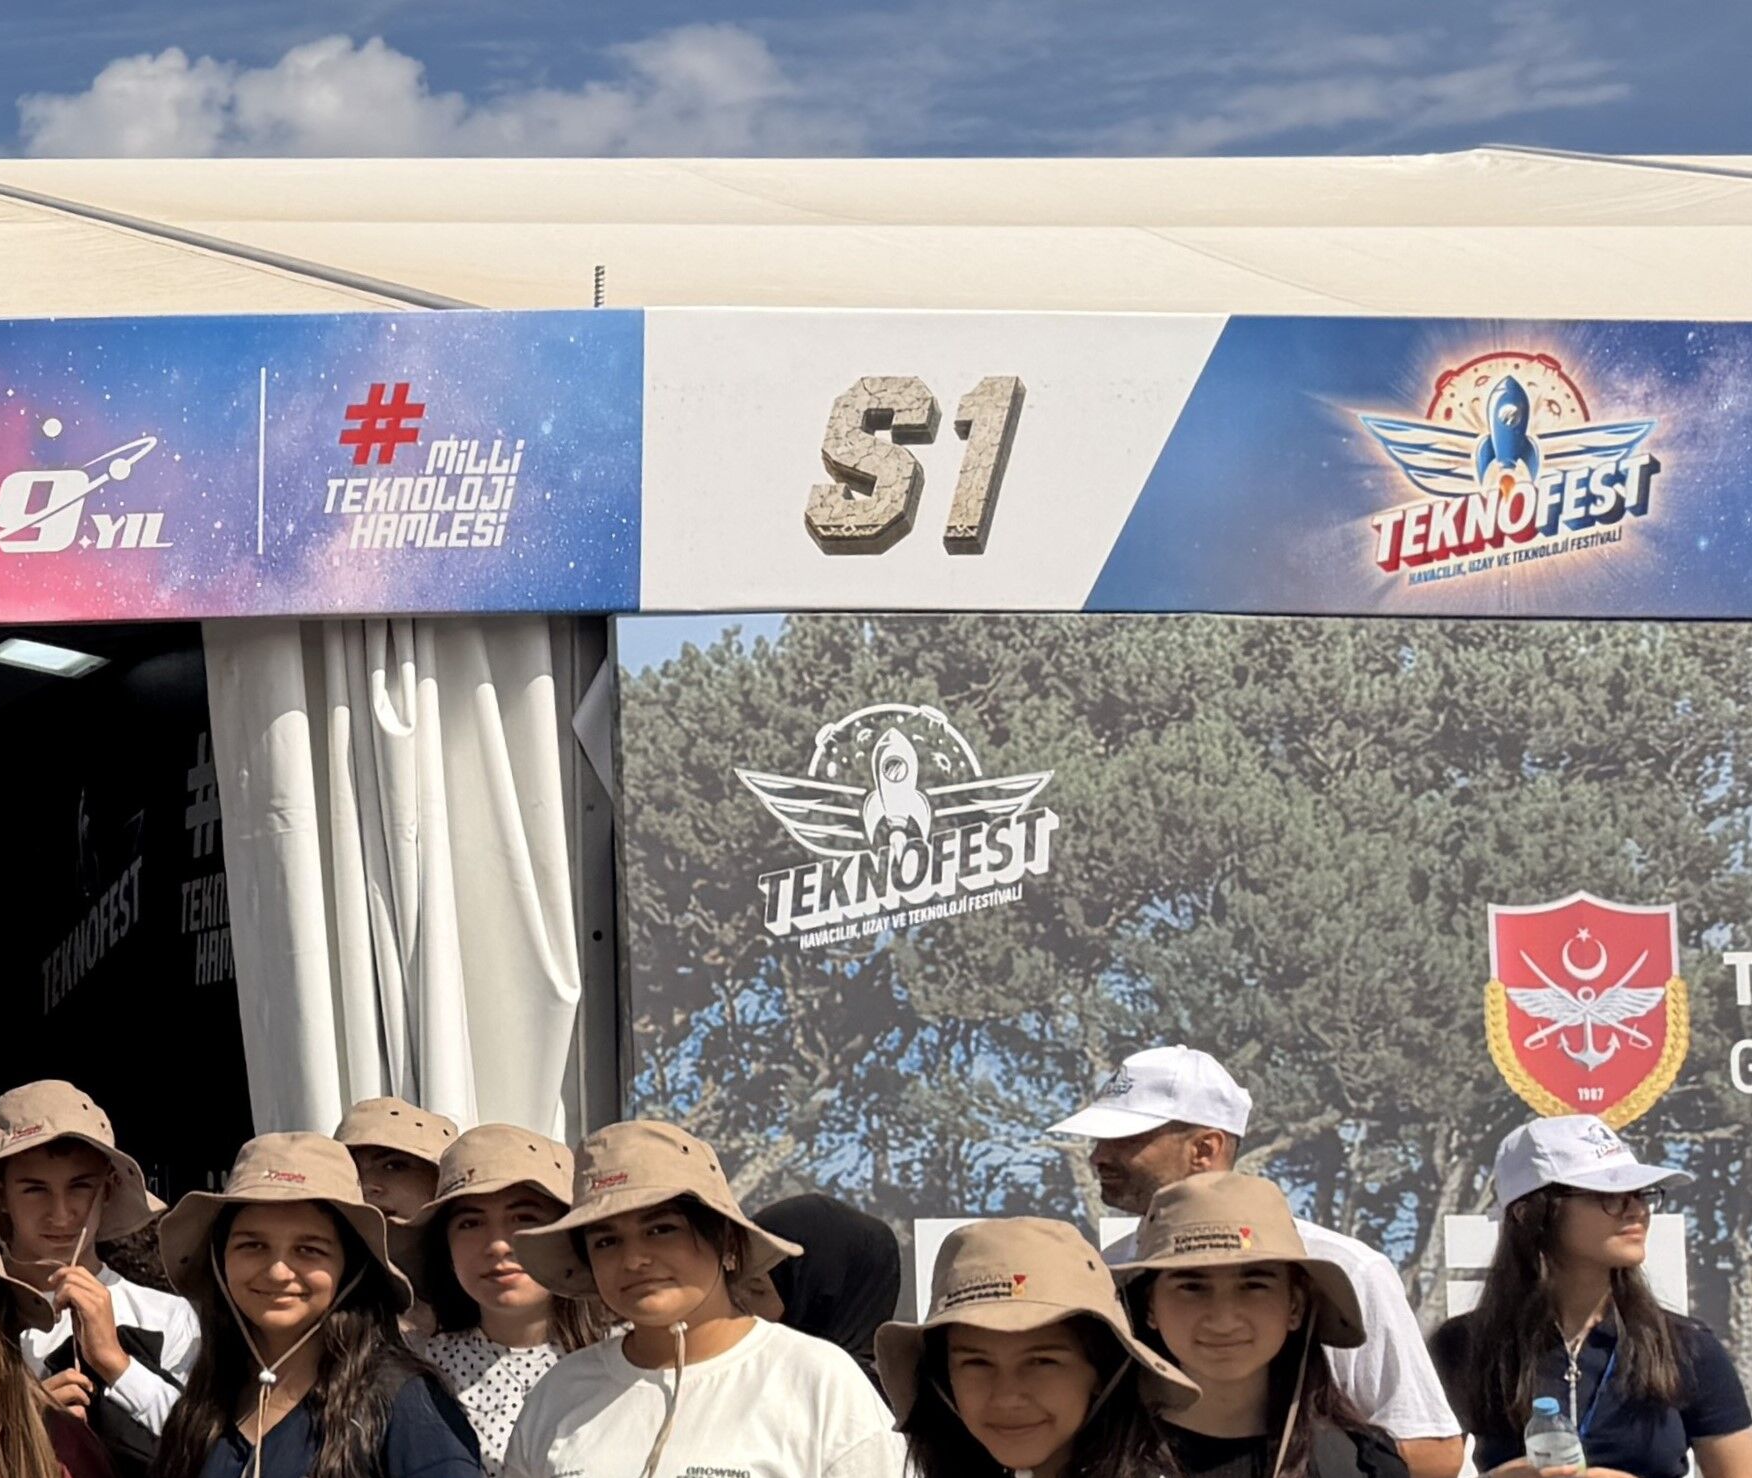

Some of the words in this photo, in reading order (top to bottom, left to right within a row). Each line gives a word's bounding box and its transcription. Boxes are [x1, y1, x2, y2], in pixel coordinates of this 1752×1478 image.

[323, 475, 516, 514] TEKNOLOJİ
[804, 376, 1027, 555] S1
[348, 511, 507, 548] HAMLESİ
[1372, 453, 1661, 573] TEKNOFEST
[1497, 553, 1511, 567] VE
[181, 872, 231, 935] TEKN
[758, 808, 1059, 936] TEKNOFEST
[41, 855, 143, 1016] TEKNOFEST
[862, 919, 888, 936] UZAY
[892, 914, 907, 929] VE
